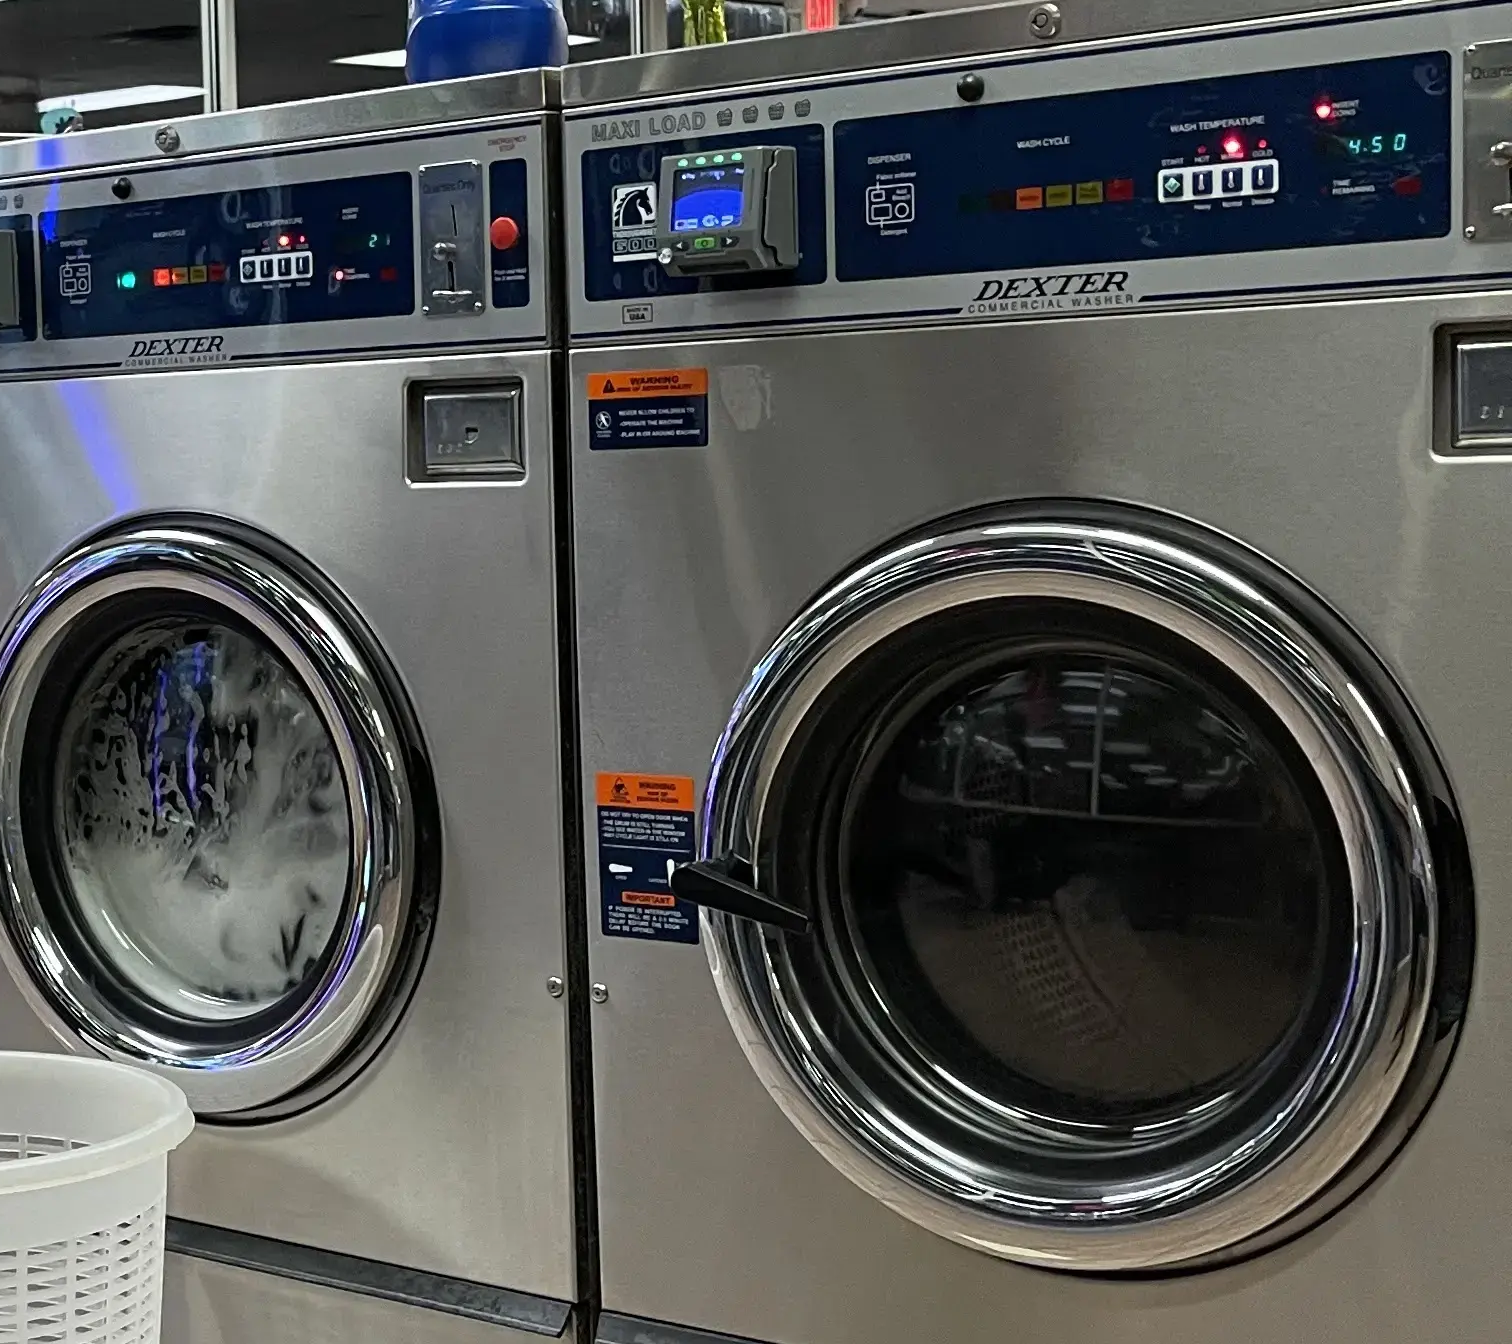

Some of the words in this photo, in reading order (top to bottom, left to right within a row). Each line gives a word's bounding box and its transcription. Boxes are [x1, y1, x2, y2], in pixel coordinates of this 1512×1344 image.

[591, 119, 641, 143] MAXI
[648, 111, 706, 136] LOAD
[1170, 123, 1197, 133] WASH
[1043, 136, 1070, 146] CYCLE
[1349, 133, 1407, 154] 4.50
[973, 271, 1129, 302] DEXTER
[968, 299, 1064, 314] COMMERCIAL
[1071, 293, 1134, 307] WASHER
[128, 336, 224, 358] DEXTER
